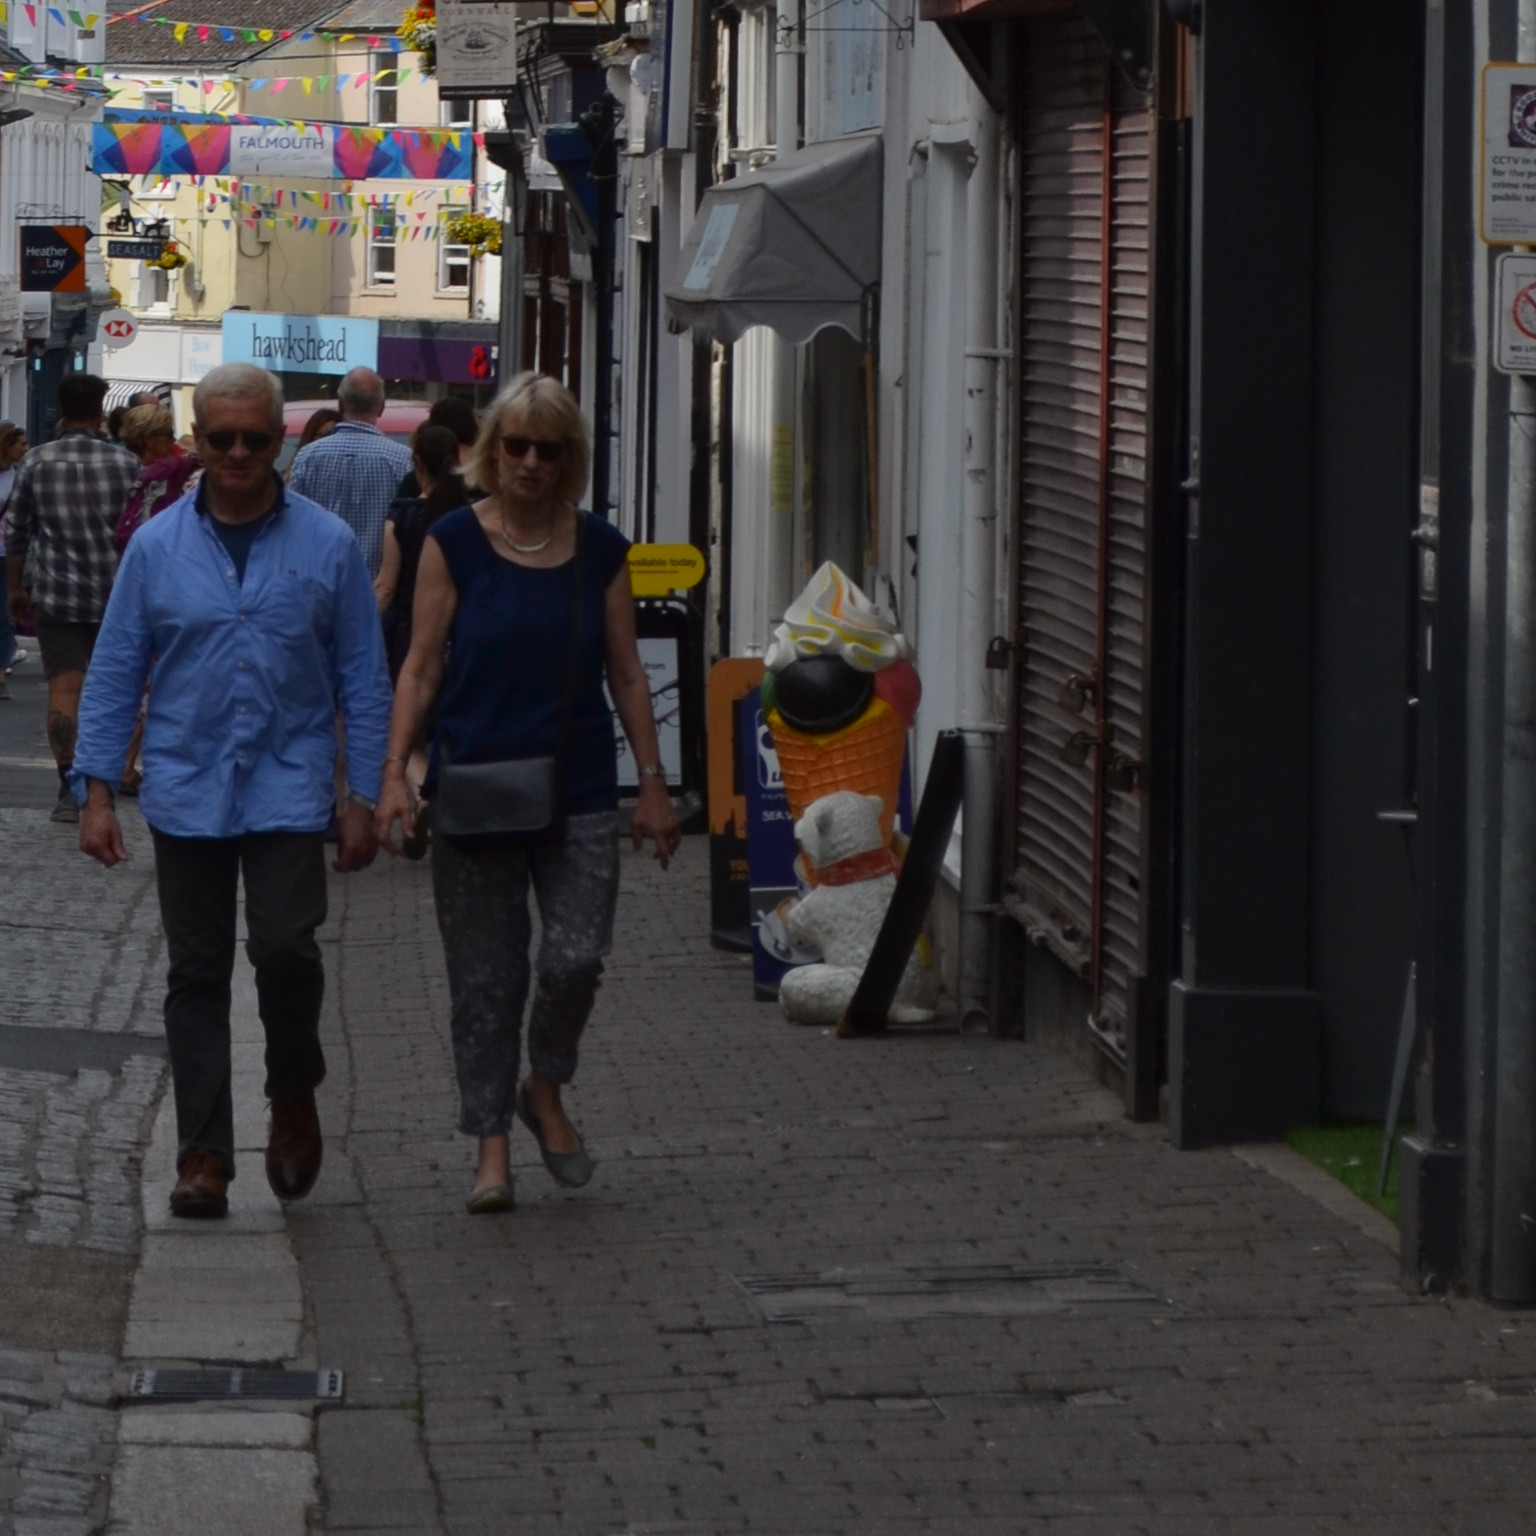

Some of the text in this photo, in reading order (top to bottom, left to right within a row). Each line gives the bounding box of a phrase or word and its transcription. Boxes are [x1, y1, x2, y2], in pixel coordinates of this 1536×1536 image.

[239, 136, 325, 151] FALMOUTH
[1492, 155, 1521, 165] CCTV
[25, 245, 69, 258] Heather
[109, 243, 160, 257] SEASALT
[46, 258, 65, 270] Lay
[252, 322, 347, 364] hawkshead
